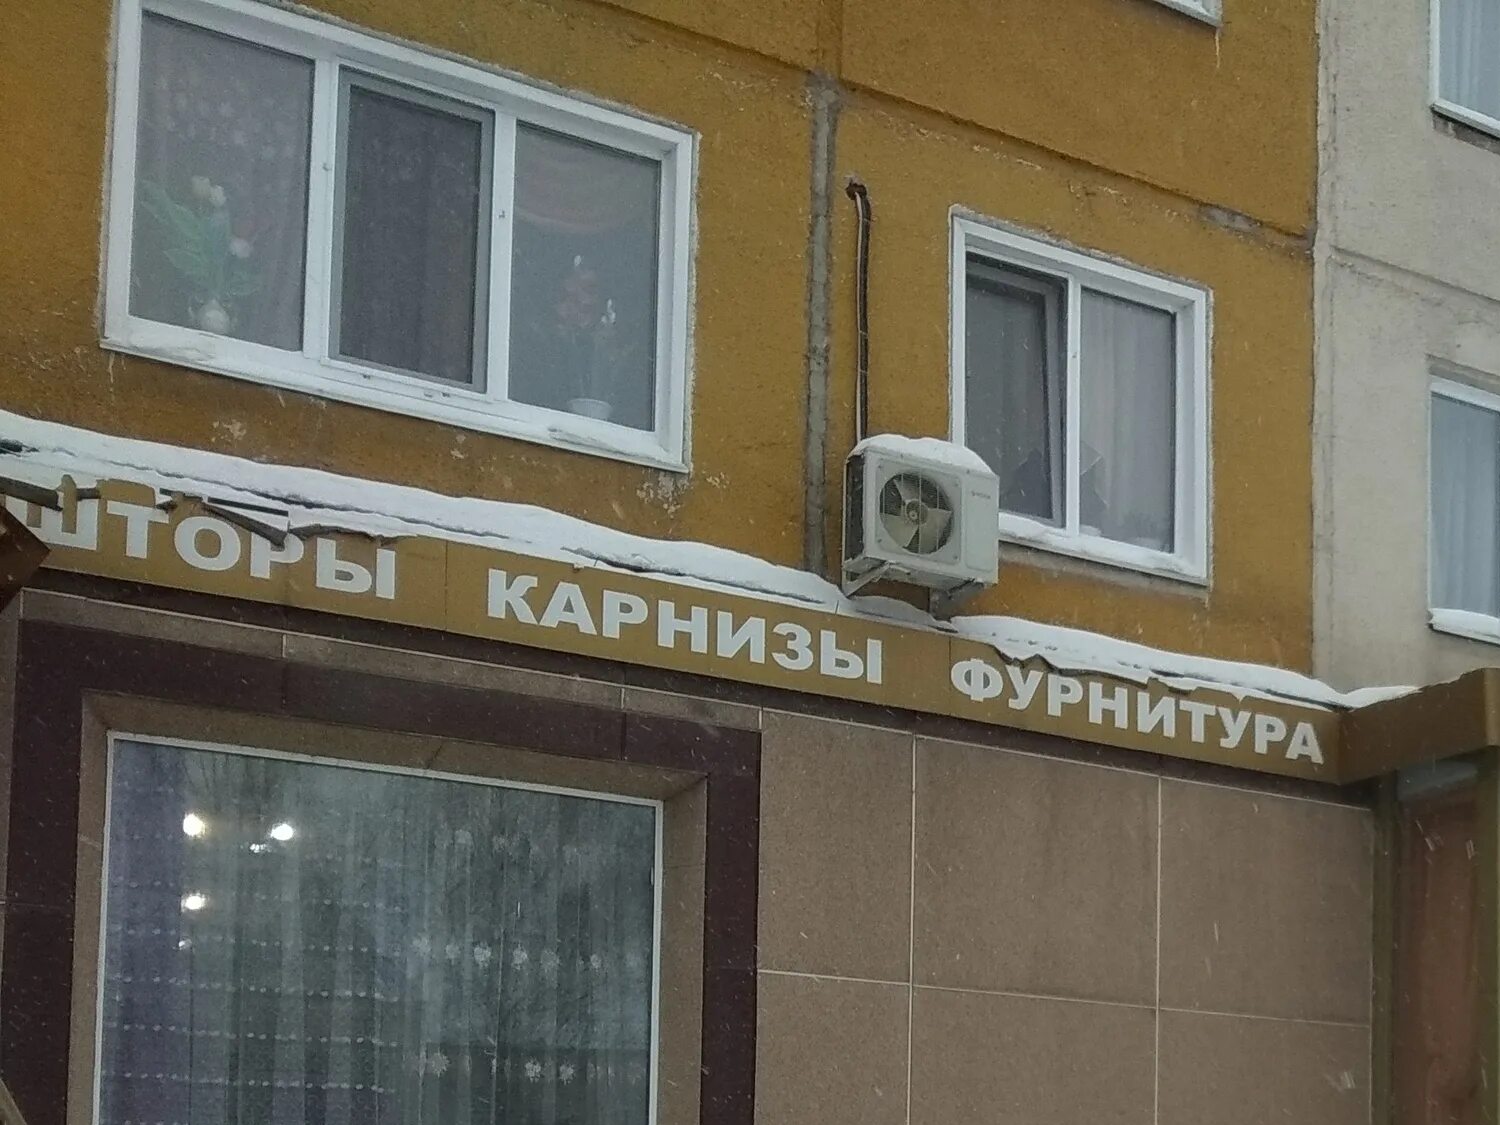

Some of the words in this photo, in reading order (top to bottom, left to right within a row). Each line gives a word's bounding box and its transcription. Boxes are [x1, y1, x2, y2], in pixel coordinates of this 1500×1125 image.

[5, 492, 396, 599] ШТОРЫ
[487, 568, 882, 685] КАРНИЗЫ
[950, 657, 1324, 764] ФУРНИТУРА
